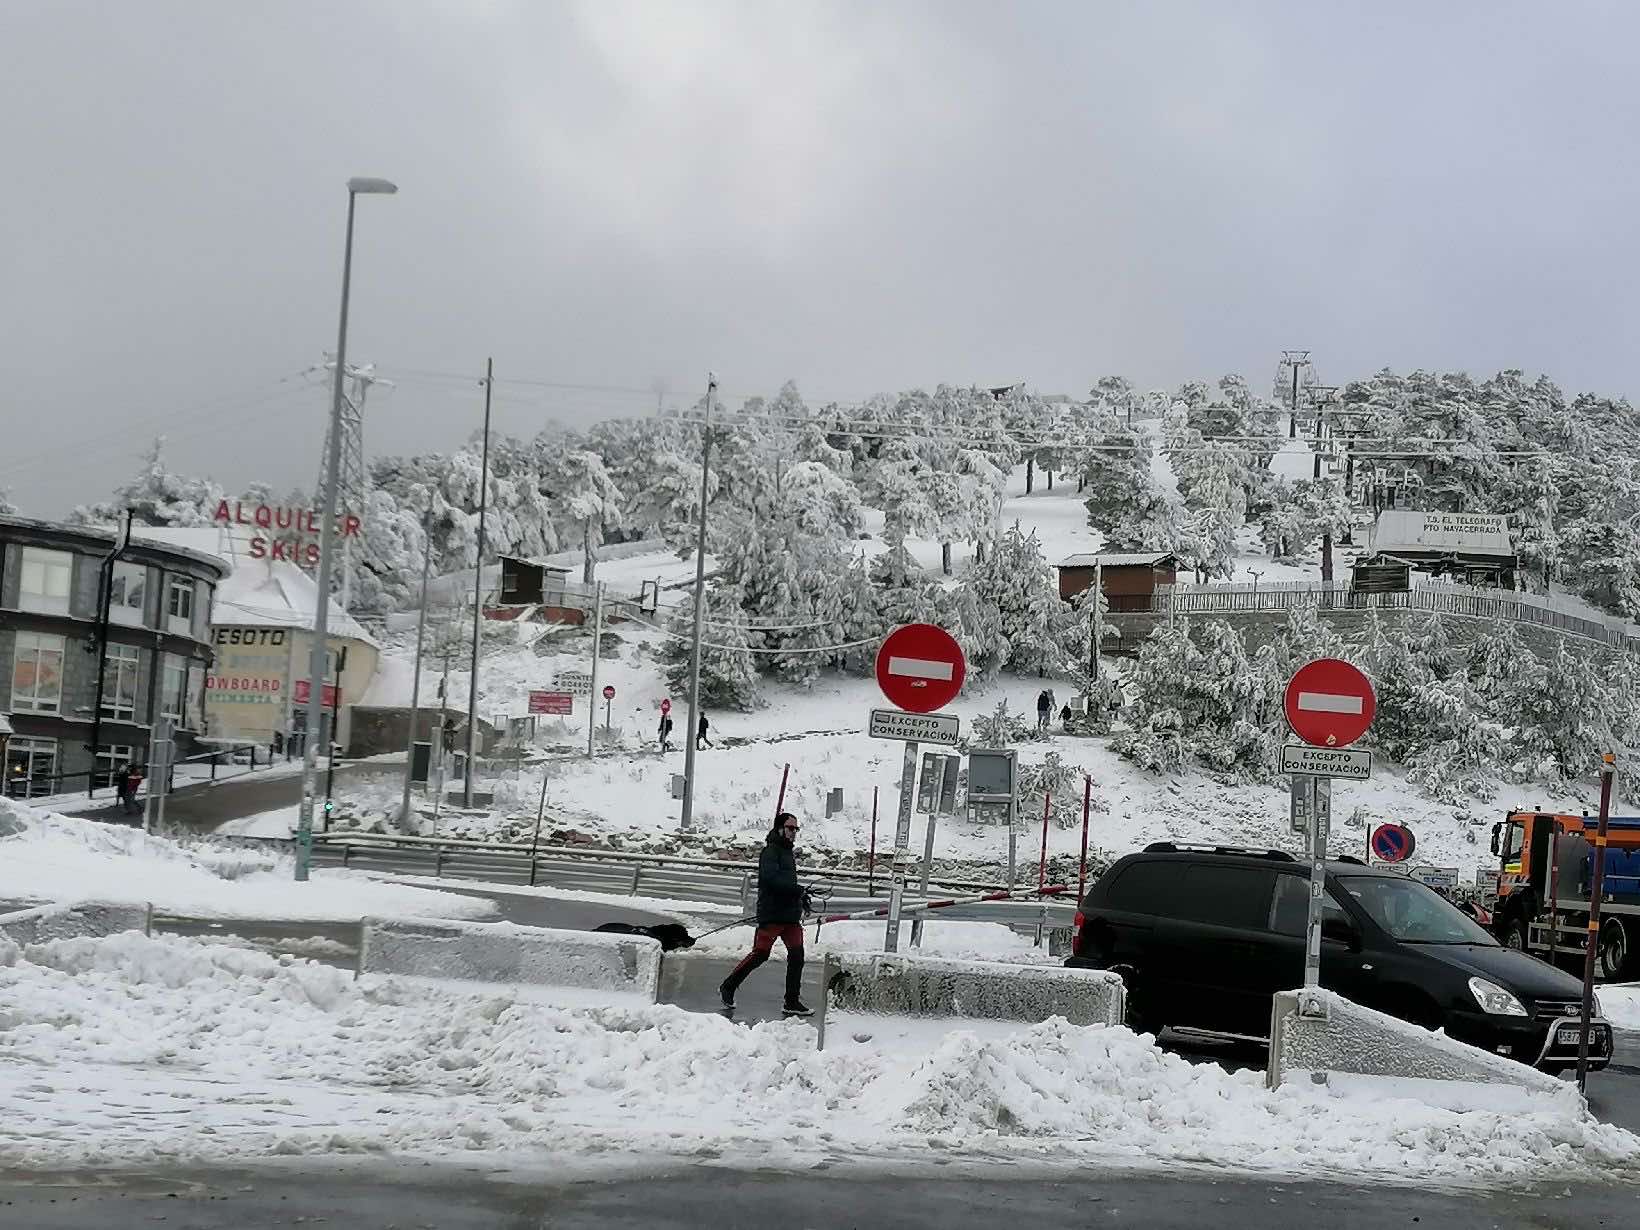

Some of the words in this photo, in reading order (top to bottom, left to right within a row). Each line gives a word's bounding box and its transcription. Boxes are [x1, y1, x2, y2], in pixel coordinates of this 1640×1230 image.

[215, 500, 360, 537] ALQUILR
[249, 537, 320, 564] SKIS
[891, 716, 939, 729] EXCEPTO
[1303, 751, 1352, 763] EXCEPTO
